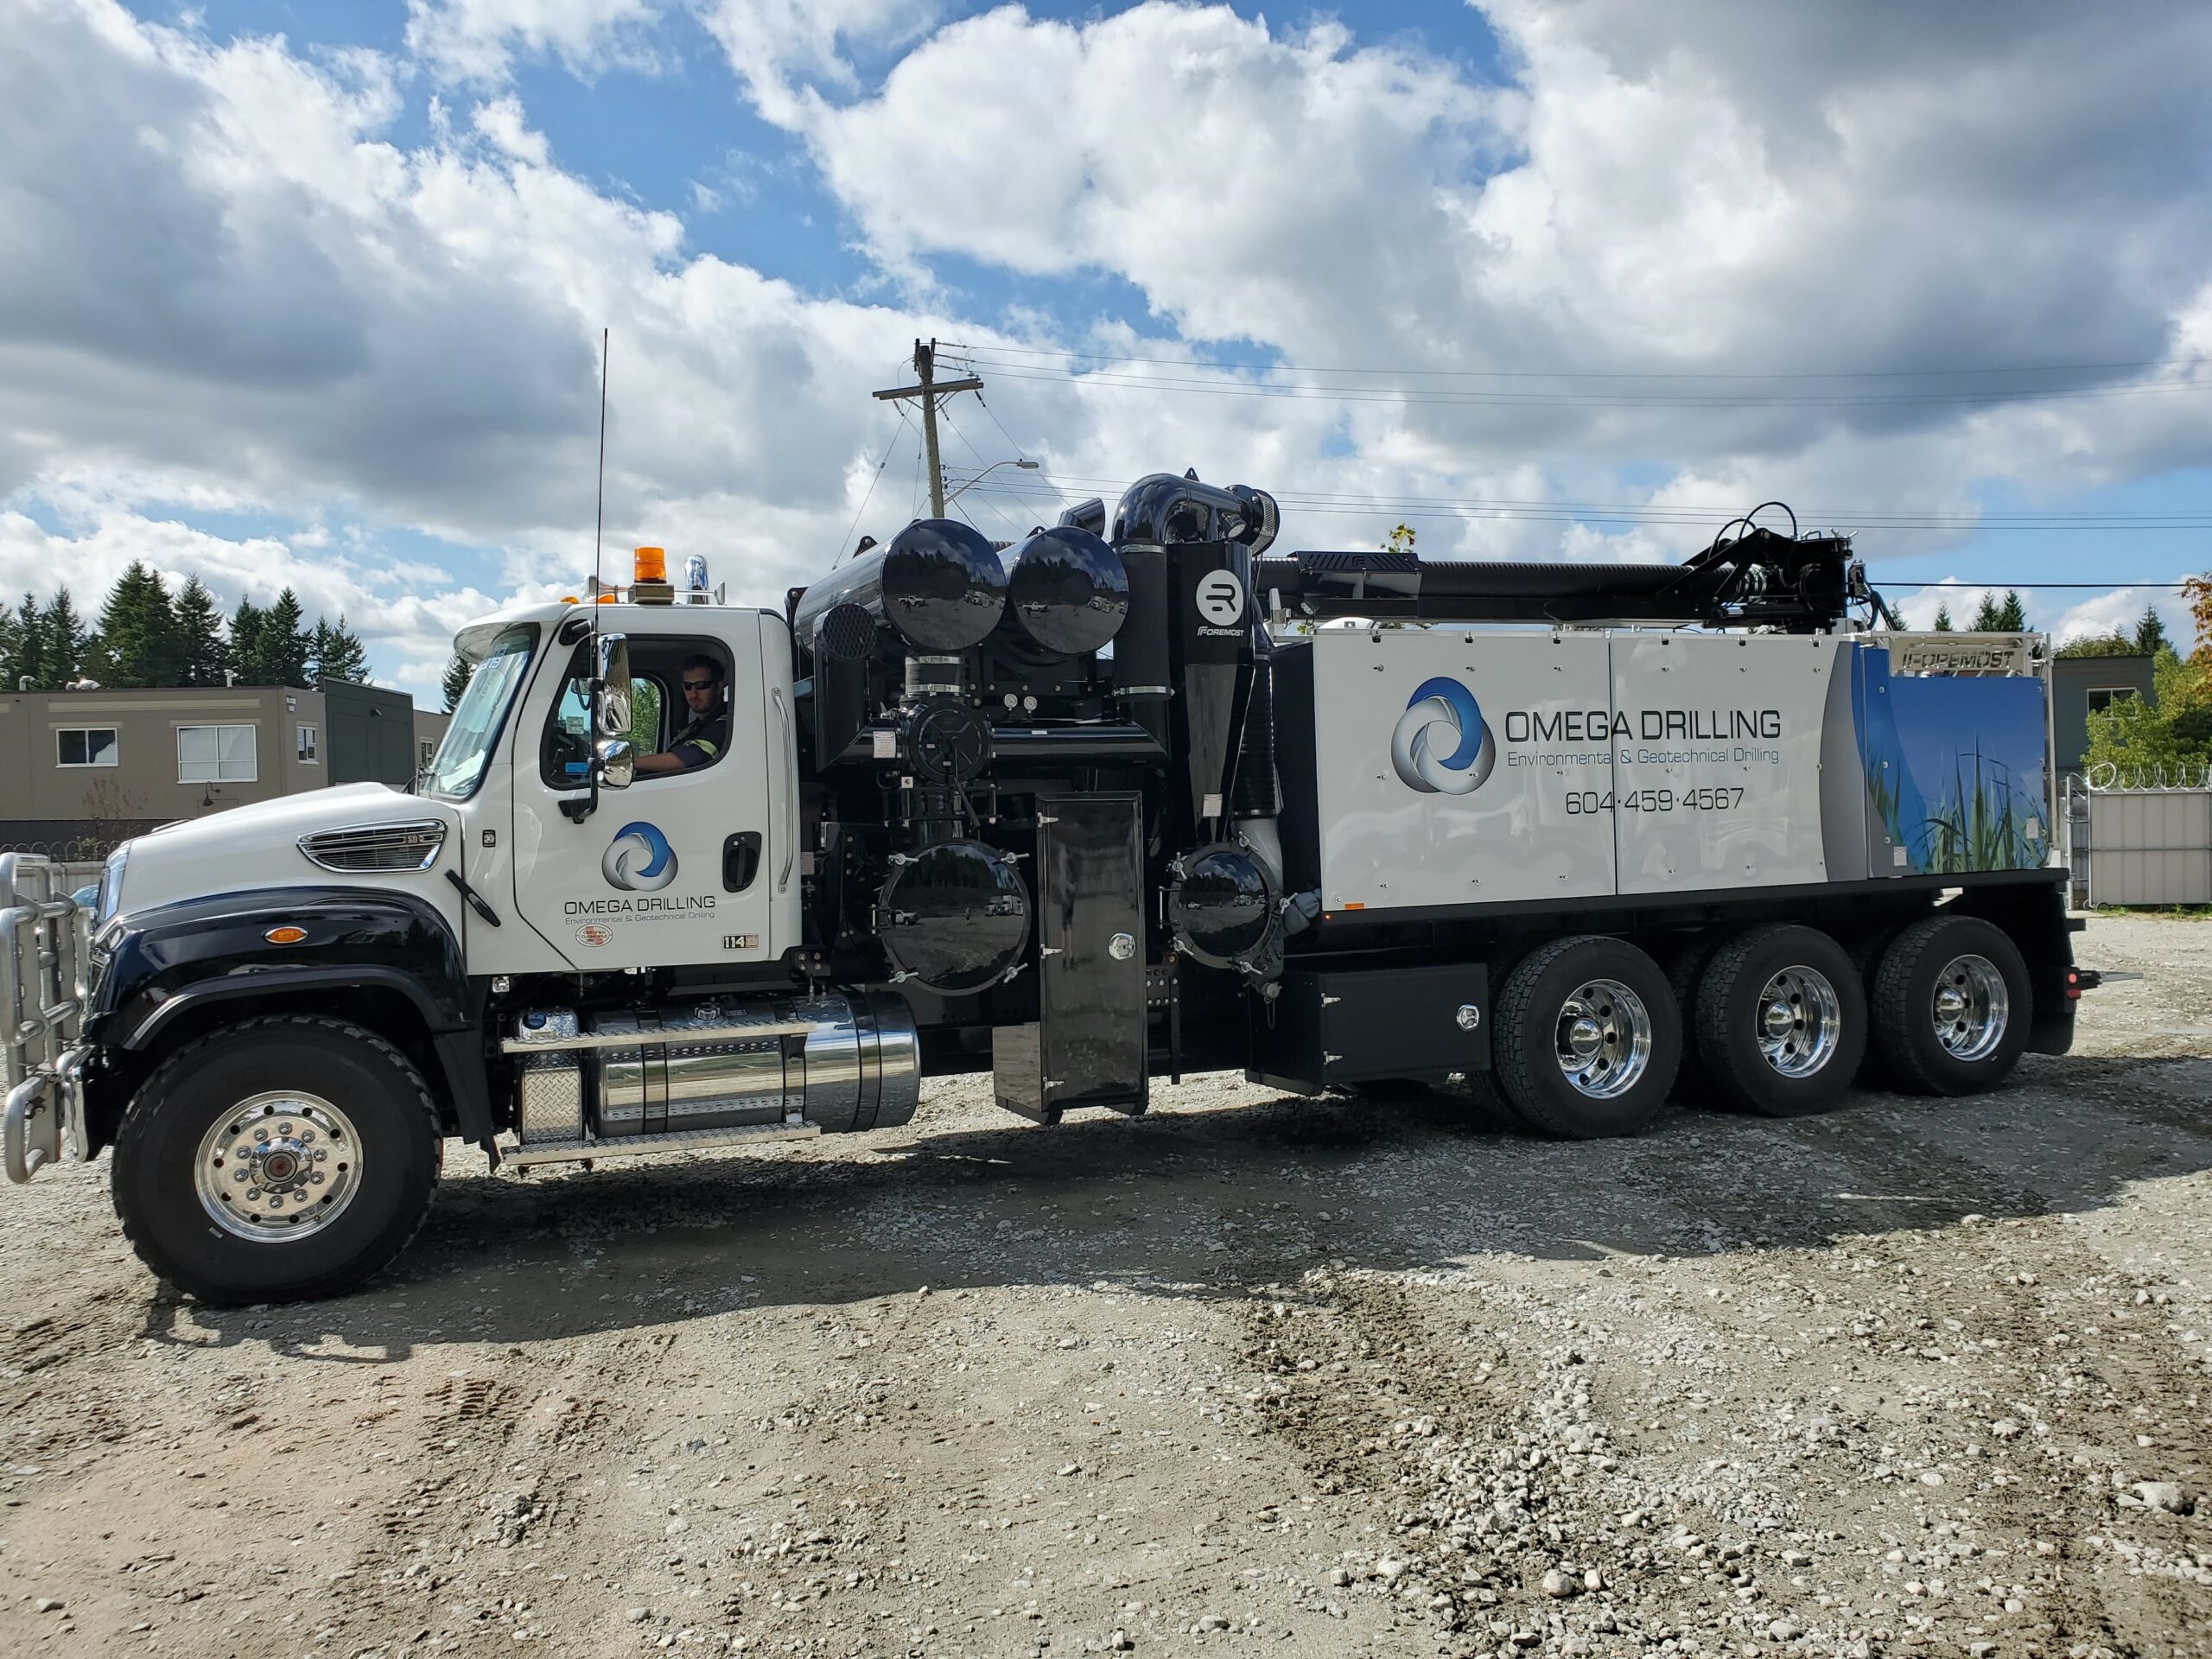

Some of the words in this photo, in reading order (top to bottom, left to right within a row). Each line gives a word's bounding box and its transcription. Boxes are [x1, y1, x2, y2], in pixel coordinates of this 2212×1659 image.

[1197, 626, 1244, 637] FOREMOST
[1505, 710, 1633, 742] OMEGA
[1641, 709, 1781, 740] DRILLING
[1507, 751, 1614, 766] Environmenta
[1620, 749, 1632, 764] &
[1637, 747, 1728, 764] Geotechnical
[1734, 747, 1779, 765] Drilling
[407, 835, 418, 844] SD
[564, 899, 633, 914] OMEGA
[637, 895, 715, 912] DRILLING
[565, 915, 623, 925] Environmental
[635, 912, 686, 922] Geotechnical
[688, 911, 715, 919] Drilling
